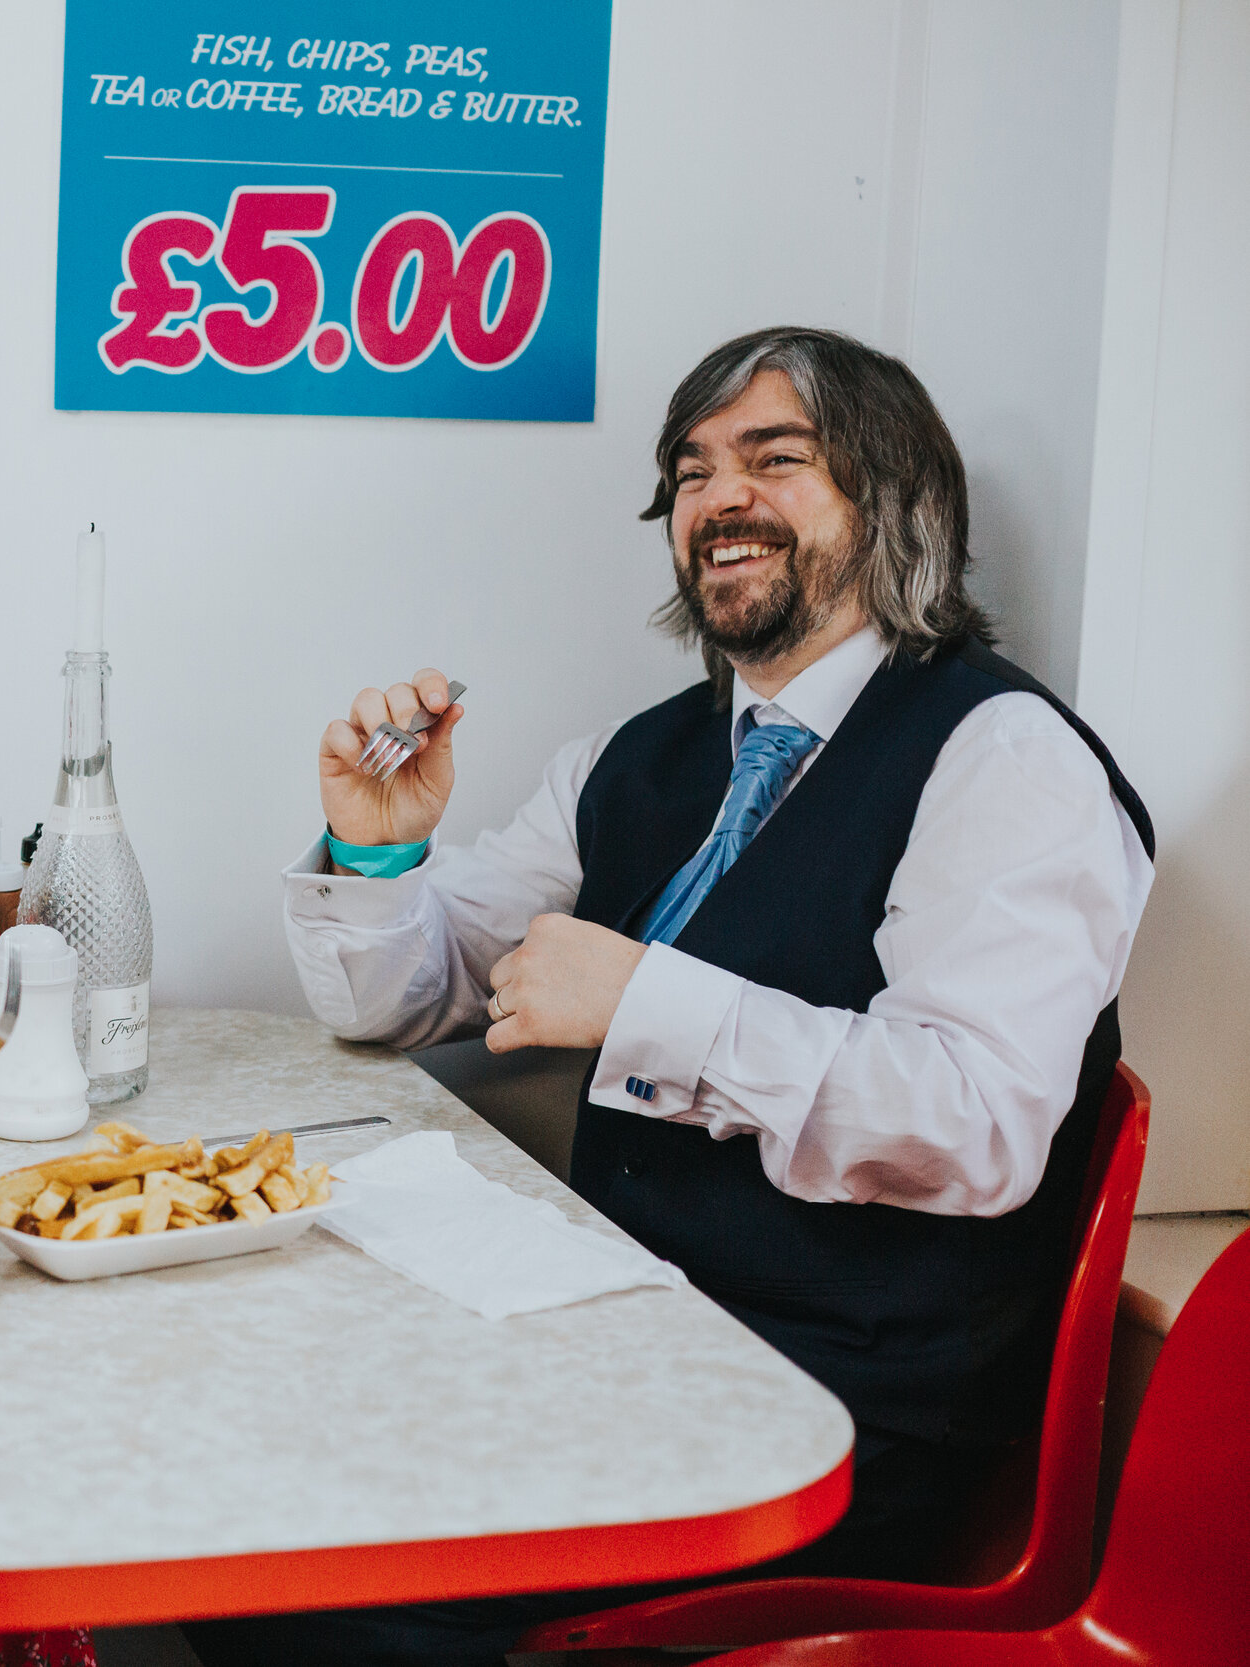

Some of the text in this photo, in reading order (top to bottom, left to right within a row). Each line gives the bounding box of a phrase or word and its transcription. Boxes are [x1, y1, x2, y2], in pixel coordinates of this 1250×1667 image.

[191, 34, 488, 82] FISH, CHIPS, PEAS,
[89, 74, 582, 127] TEA OR COFFEE, BREAD & BUTTER.
[97, 185, 553, 375] £5.00
